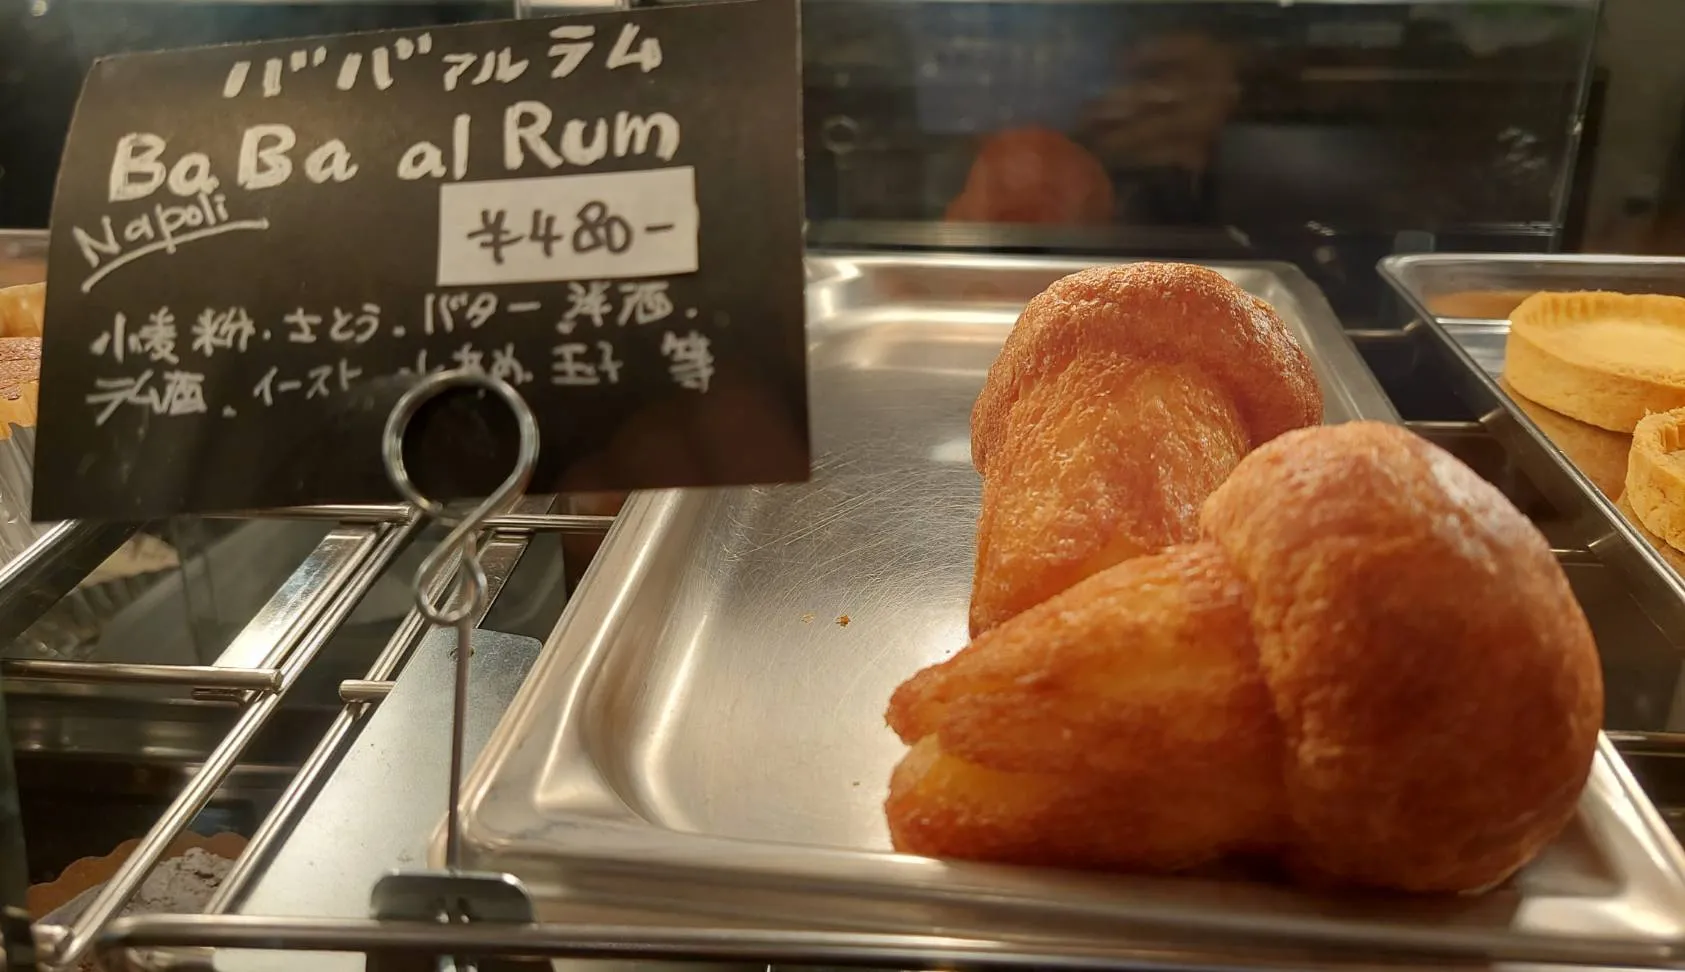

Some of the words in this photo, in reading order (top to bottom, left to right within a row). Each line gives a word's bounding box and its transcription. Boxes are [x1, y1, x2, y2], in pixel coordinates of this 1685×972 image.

[397, 114, 471, 180] al
[504, 100, 681, 170] Rum
[72, 194, 229, 268] Napoli
